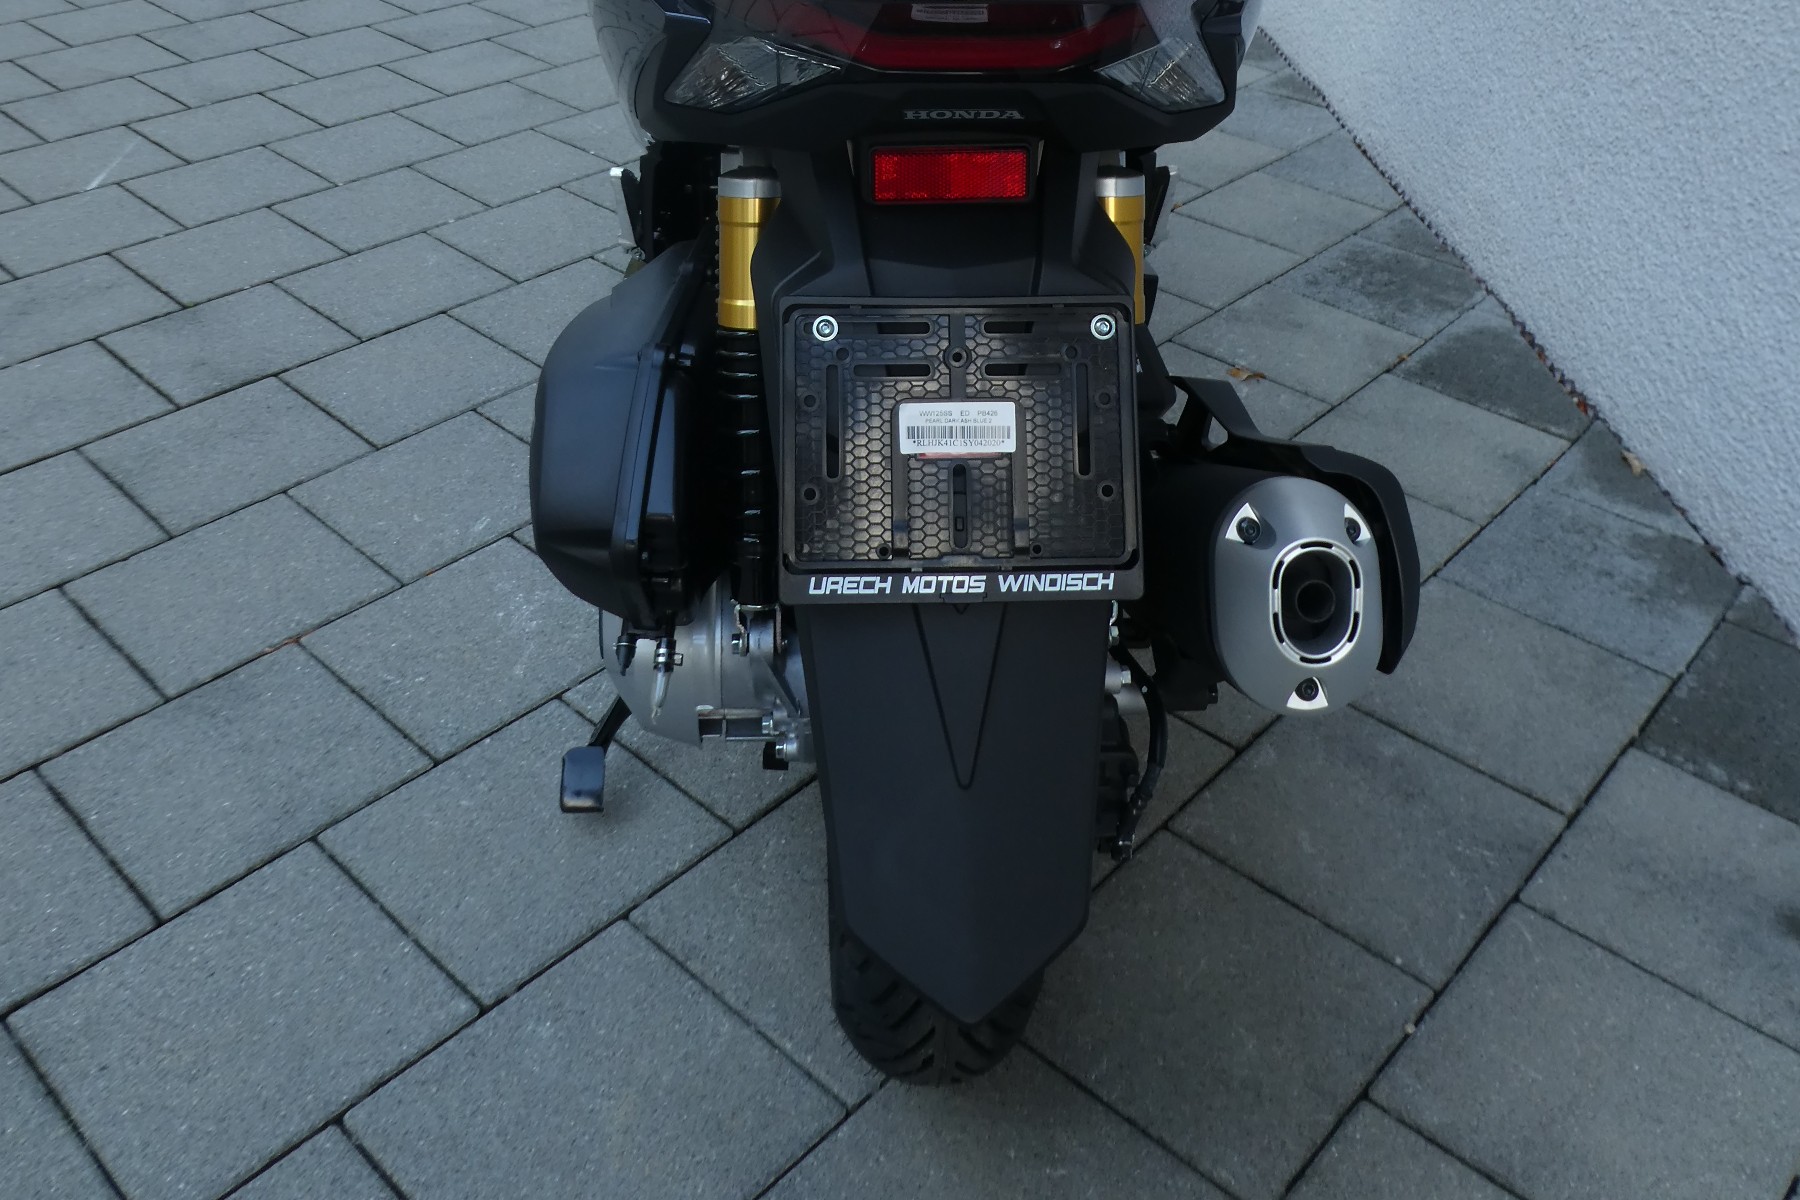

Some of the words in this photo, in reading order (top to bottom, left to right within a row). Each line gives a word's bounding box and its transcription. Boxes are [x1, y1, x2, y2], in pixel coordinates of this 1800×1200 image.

[904, 110, 1024, 120] HONDA
[808, 576, 893, 595] URECH
[902, 575, 987, 593] MOTOS
[998, 572, 1115, 592] WINDISCH
